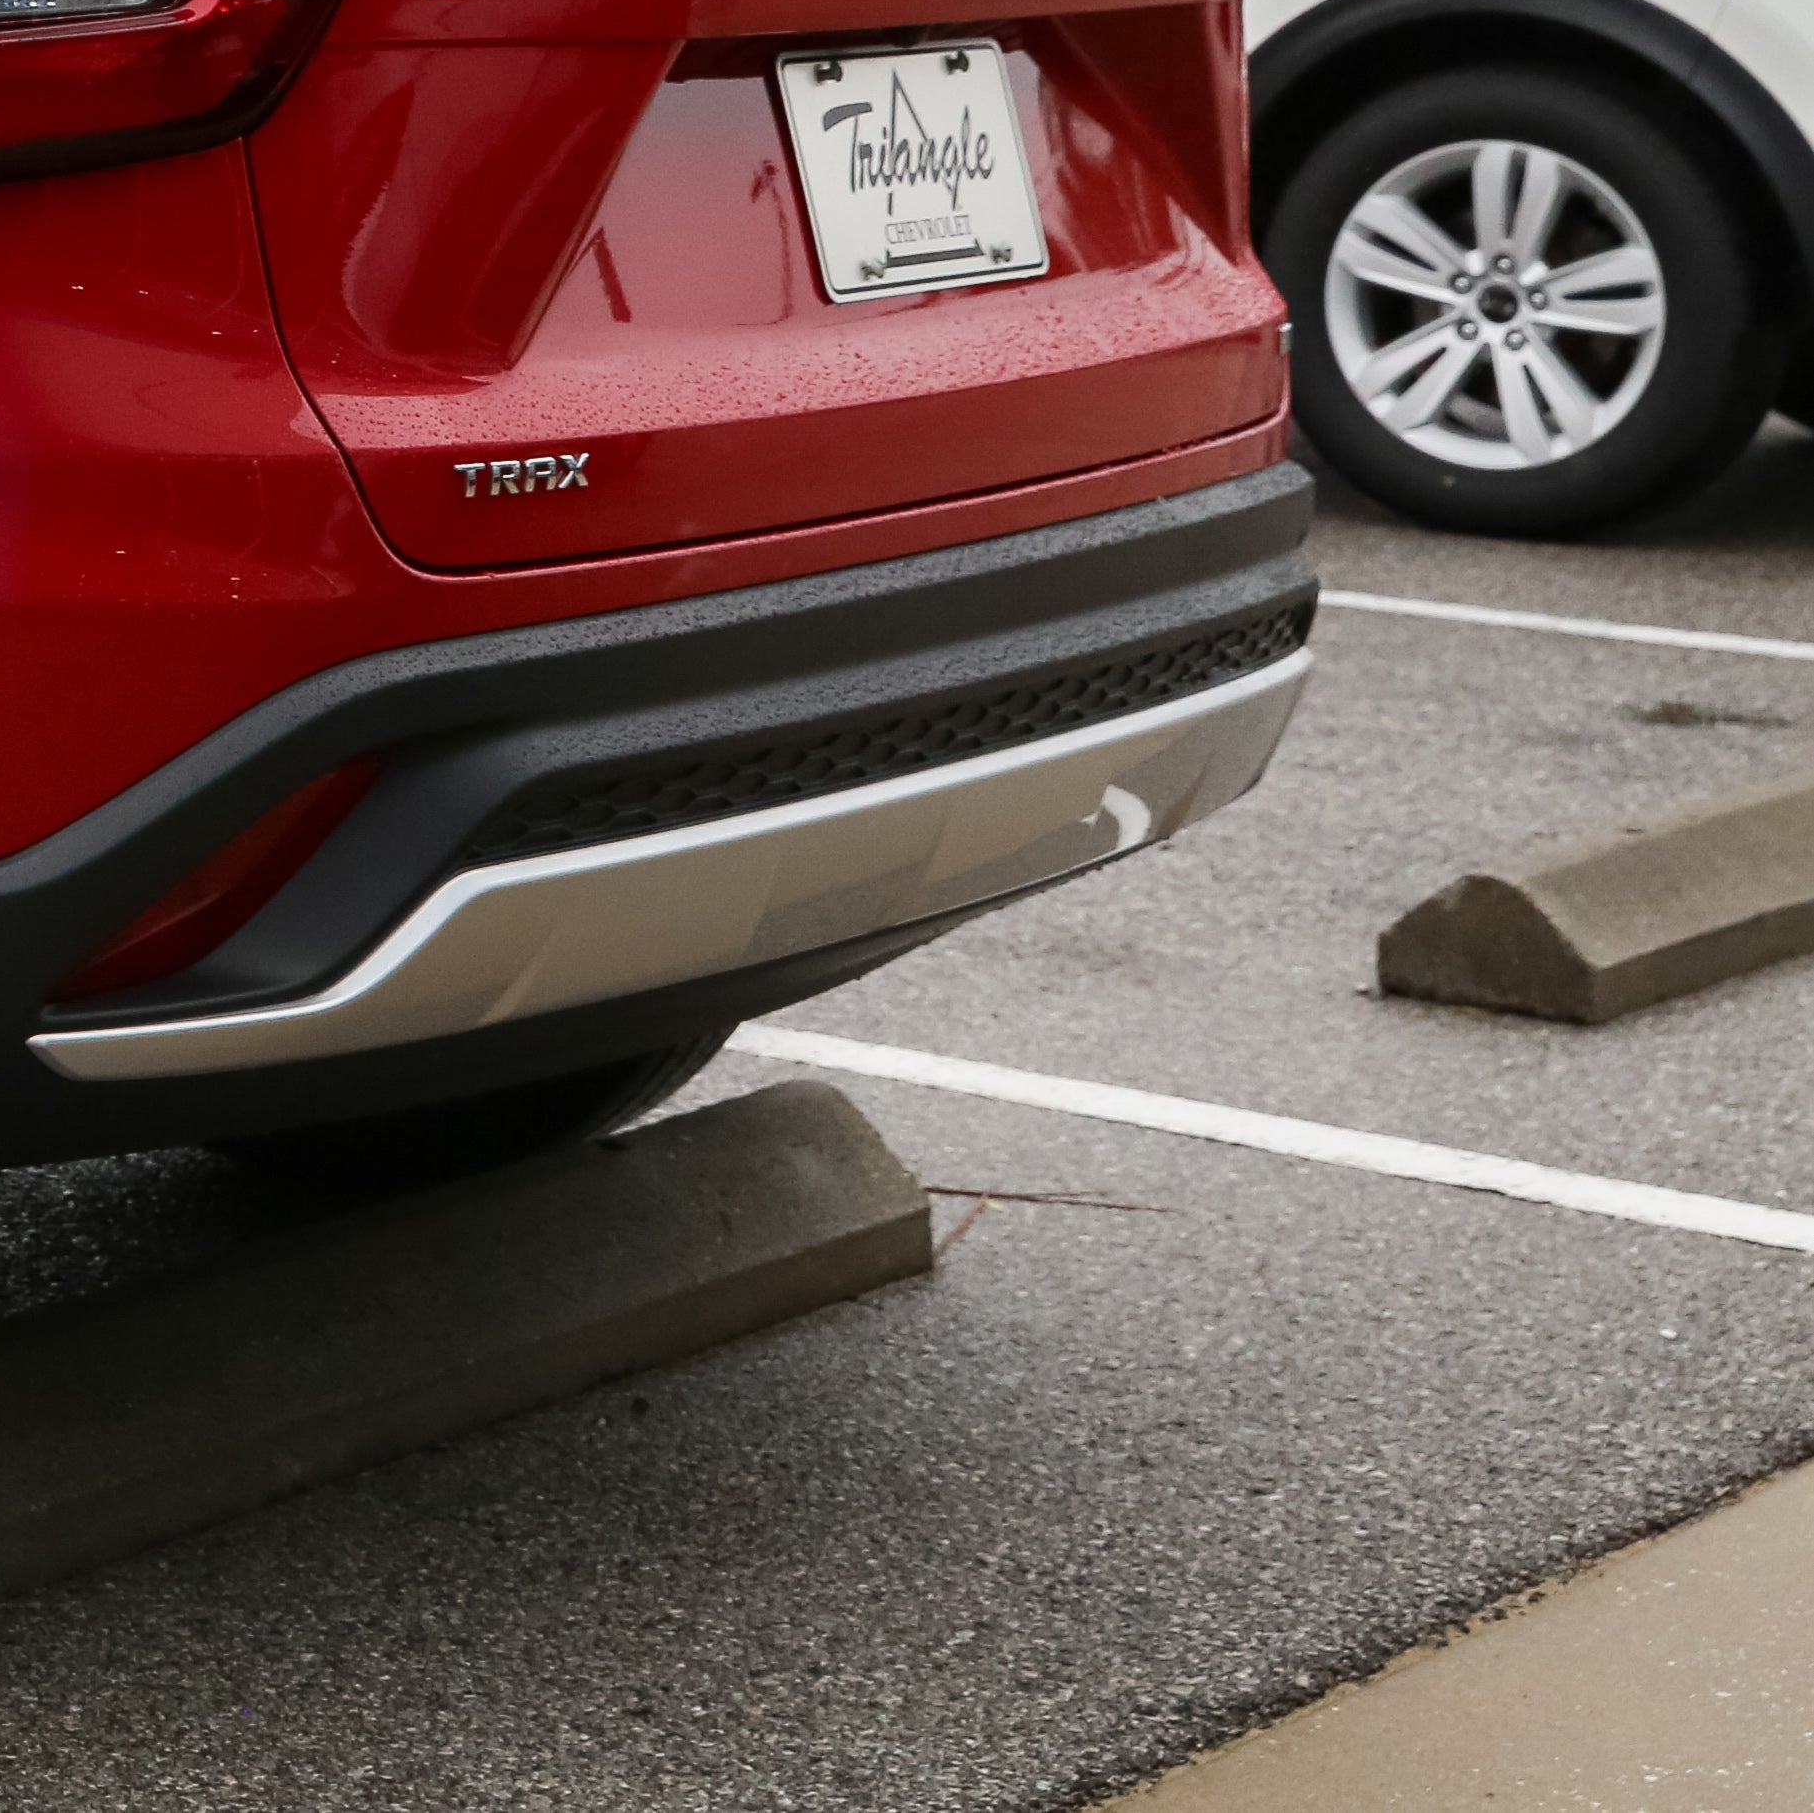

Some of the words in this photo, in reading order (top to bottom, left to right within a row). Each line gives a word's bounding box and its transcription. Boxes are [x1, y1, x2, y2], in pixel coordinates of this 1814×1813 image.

[822, 101, 995, 212] Triangle
[884, 214, 973, 245] CHEVROLET
[454, 452, 590, 498] TRAX
